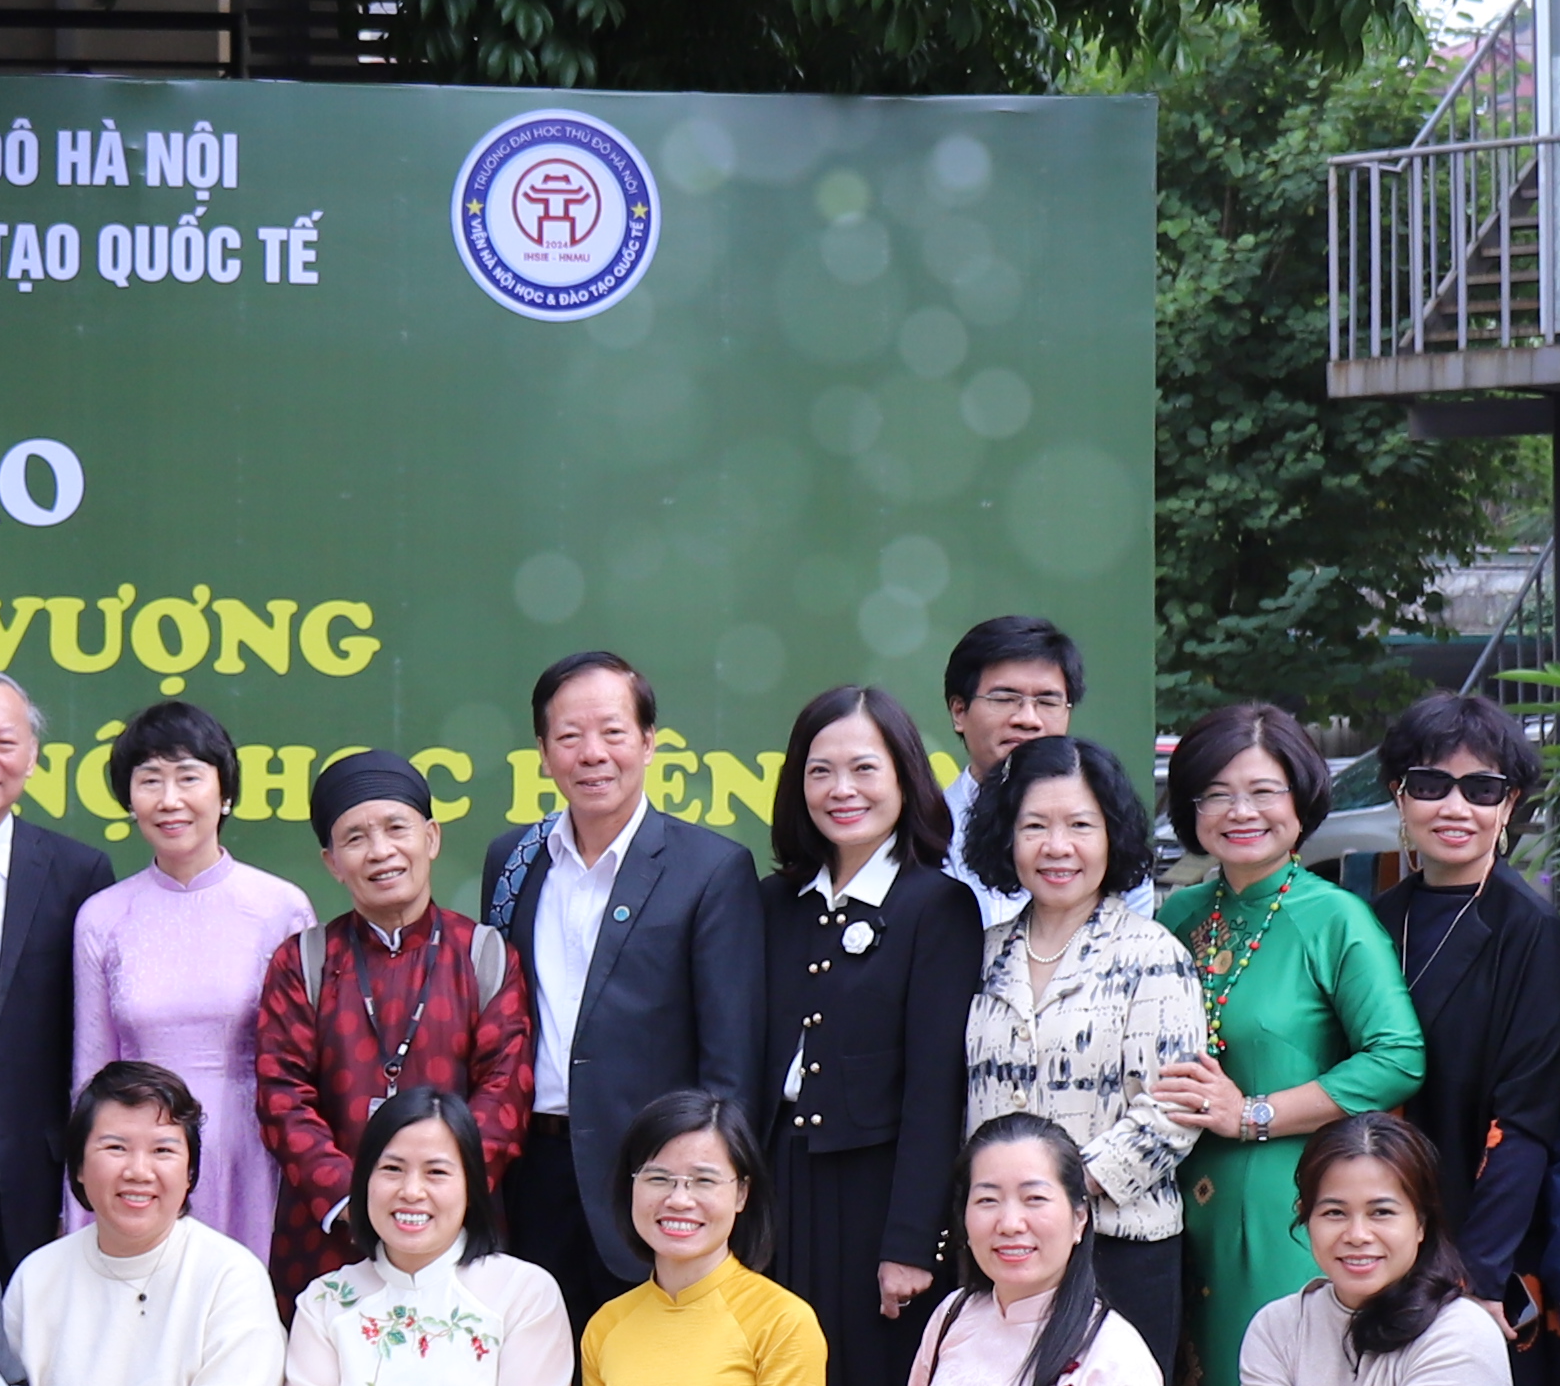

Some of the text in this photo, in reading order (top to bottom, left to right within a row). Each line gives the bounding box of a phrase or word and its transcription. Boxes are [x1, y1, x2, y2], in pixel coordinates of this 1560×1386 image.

[57, 118, 129, 187] HÀ
[146, 121, 238, 201] NỘI
[474, 143, 511, 191] TRƯỜNG
[509, 130, 532, 149] ĐẠI
[591, 135, 611, 155] ĐÔ
[97, 205, 242, 288] QUỐC
[258, 210, 323, 284] TẾ
[469, 218, 645, 306] VIỆN HÀ NỘI HỌC & ĐÀO TẠO QUỐC TẾ
[545, 240, 569, 250] 2024
[233, 744, 473, 825] HC
